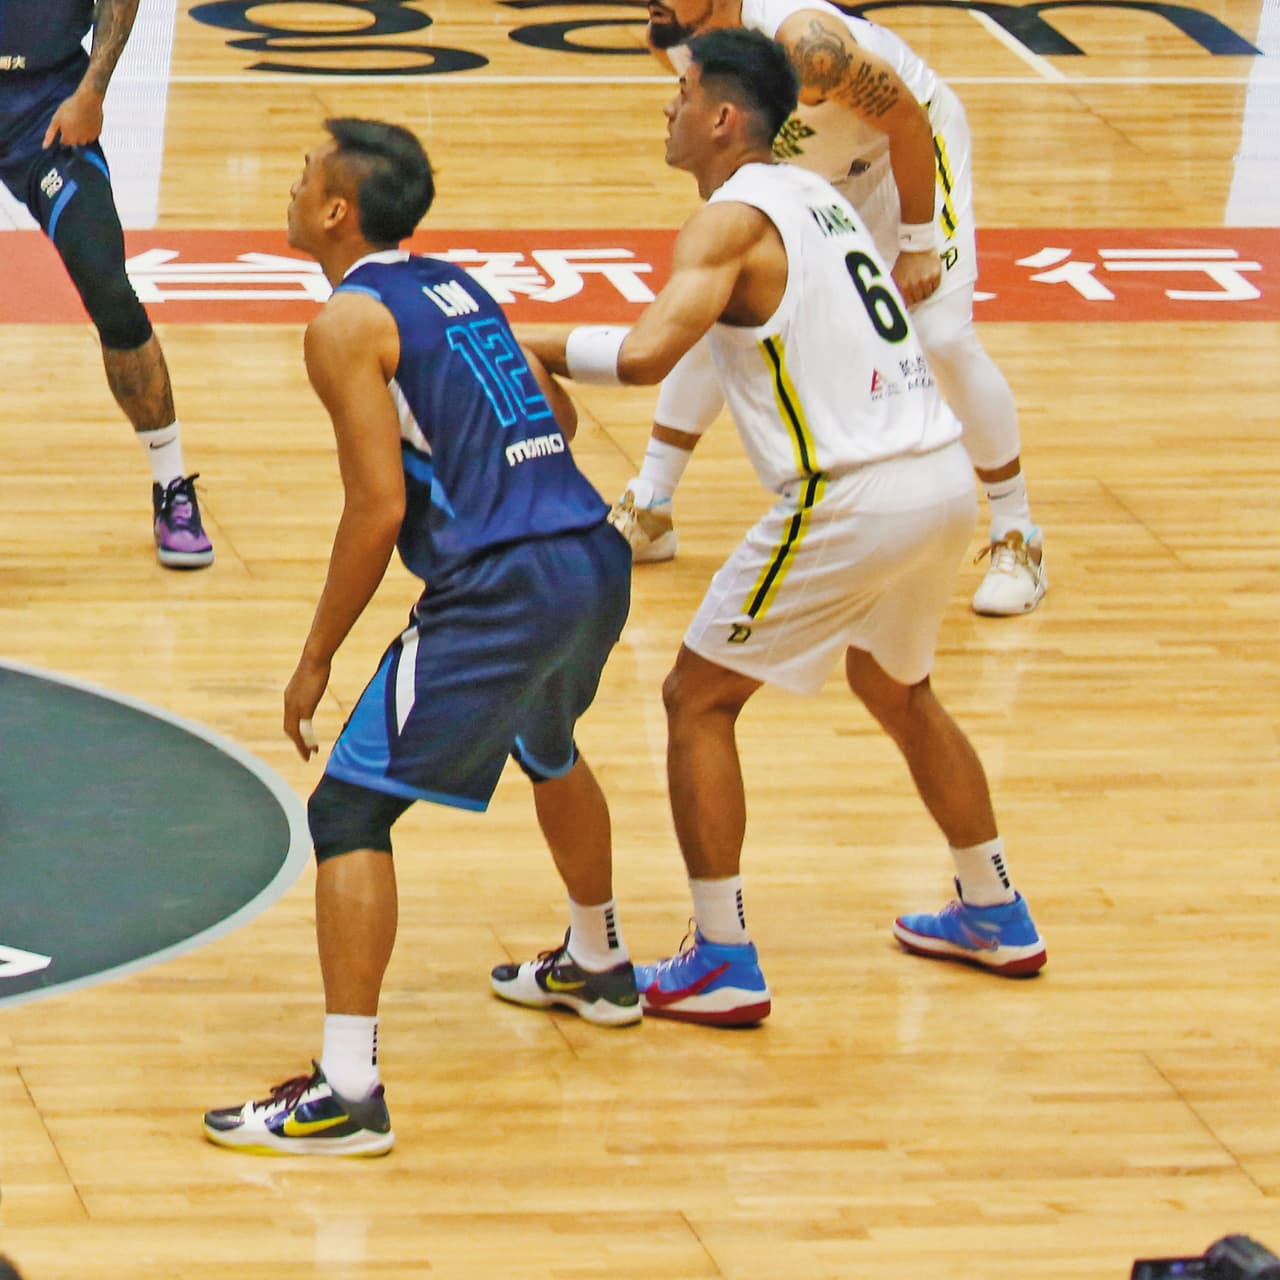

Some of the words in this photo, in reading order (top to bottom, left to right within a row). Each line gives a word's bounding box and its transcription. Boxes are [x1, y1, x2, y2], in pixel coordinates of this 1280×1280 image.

[128, 247, 1263, 304] 台新行
[421, 278, 481, 318] LIN
[844, 249, 909, 344] 6
[445, 317, 554, 428] 12
